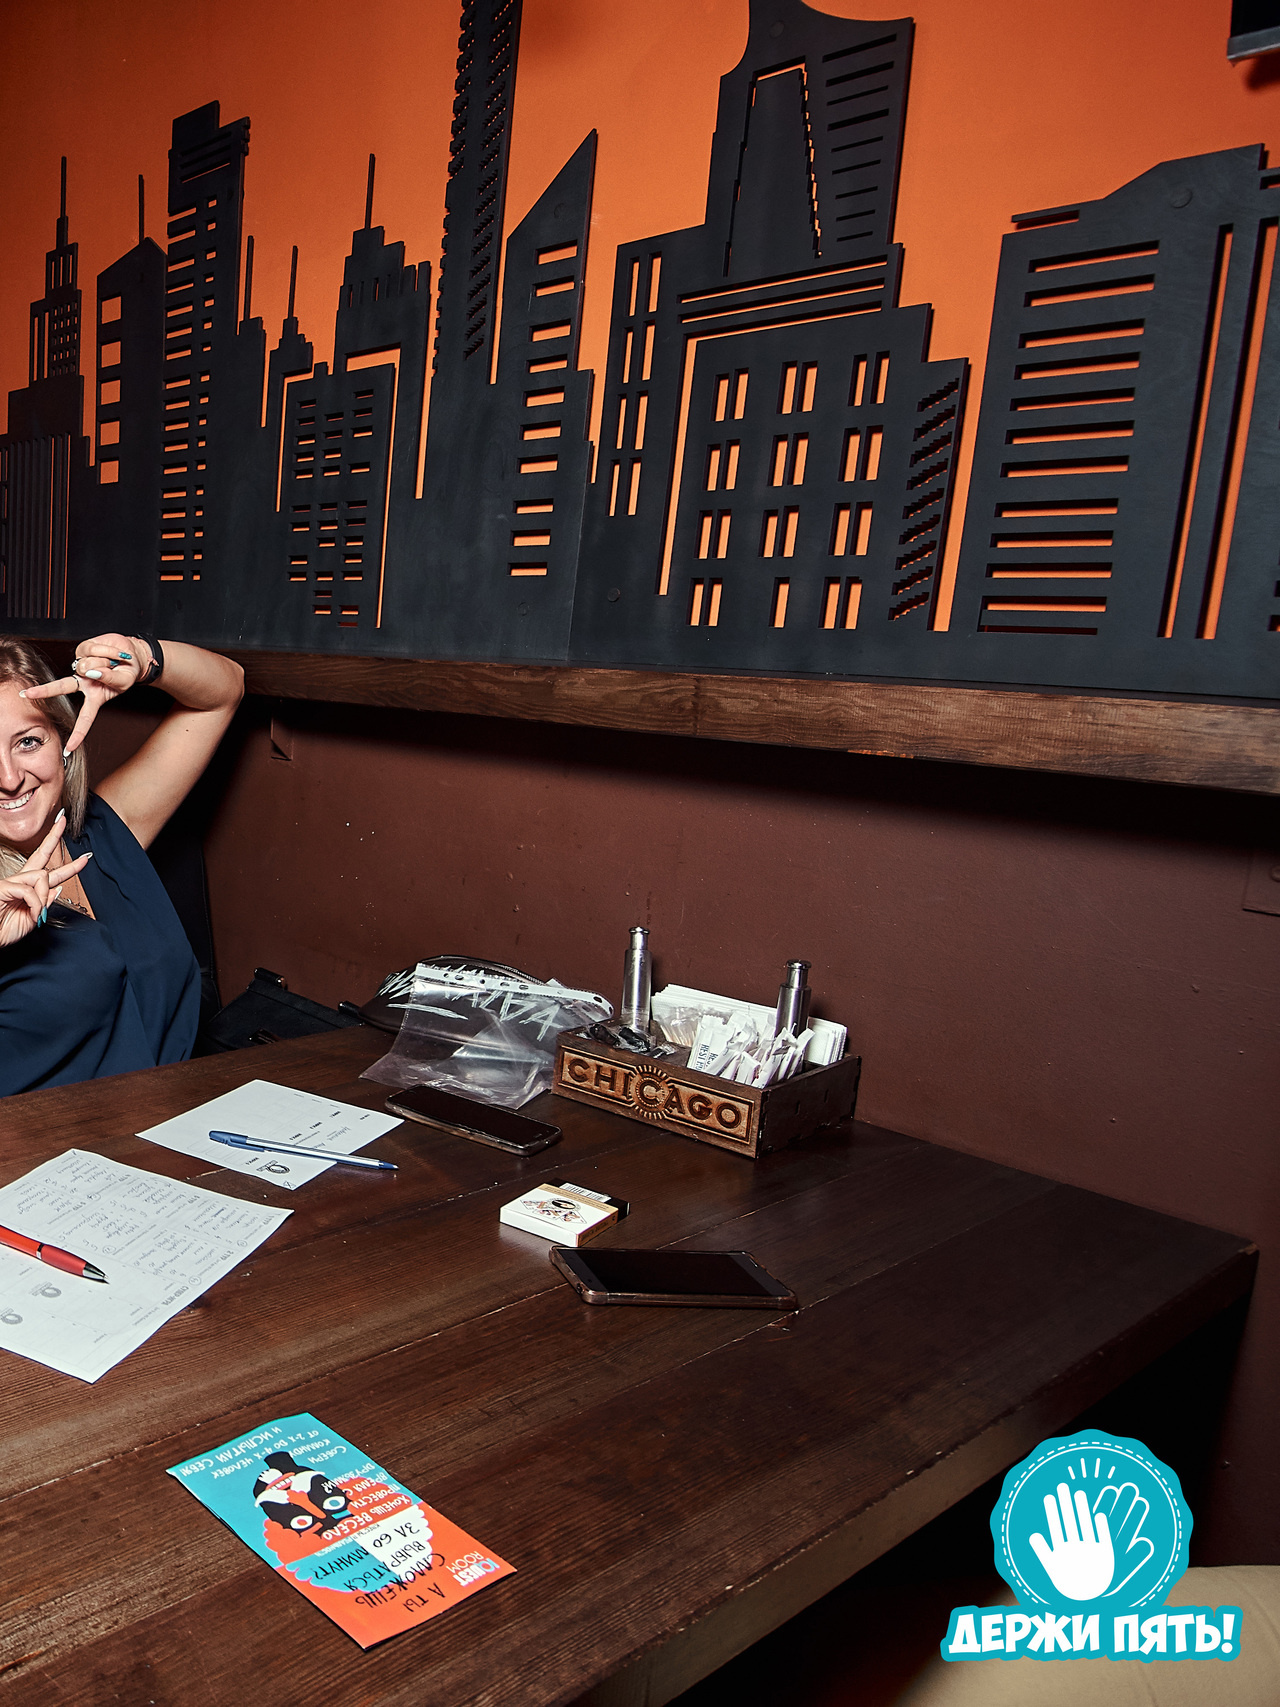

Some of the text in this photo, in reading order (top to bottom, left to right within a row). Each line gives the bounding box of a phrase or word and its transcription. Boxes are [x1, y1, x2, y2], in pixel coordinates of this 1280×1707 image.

[567, 1057, 742, 1129] CHICAGO
[270, 1438, 288, 1449] ДО
[286, 1438, 332, 1457] КОМАНДУ
[304, 1429, 320, 1438] ОТ
[177, 1426, 283, 1477] И ИСПЫТАЙ СЕБЯ!
[306, 1443, 349, 1465] СОБЕРИ
[208, 1456, 255, 1479] ЧЕЛОВЕК
[319, 1462, 375, 1493] ДРУЗЬЯМИ?
[340, 1471, 389, 1496] ВРЕМЯ С
[348, 1482, 401, 1509] ПРОВЕСТИ
[318, 1494, 411, 1541] ХОЧЕШЬ ВЕСЕЛО
[307, 1521, 420, 1580] ЗА 60 МИНУТ?
[443, 1550, 484, 1573] ROOM
[342, 1539, 426, 1592] ВЫБРАТЬСЯ
[353, 1551, 448, 1611] СМОЖЕШЬ
[400, 1582, 449, 1612] А ТЫ
